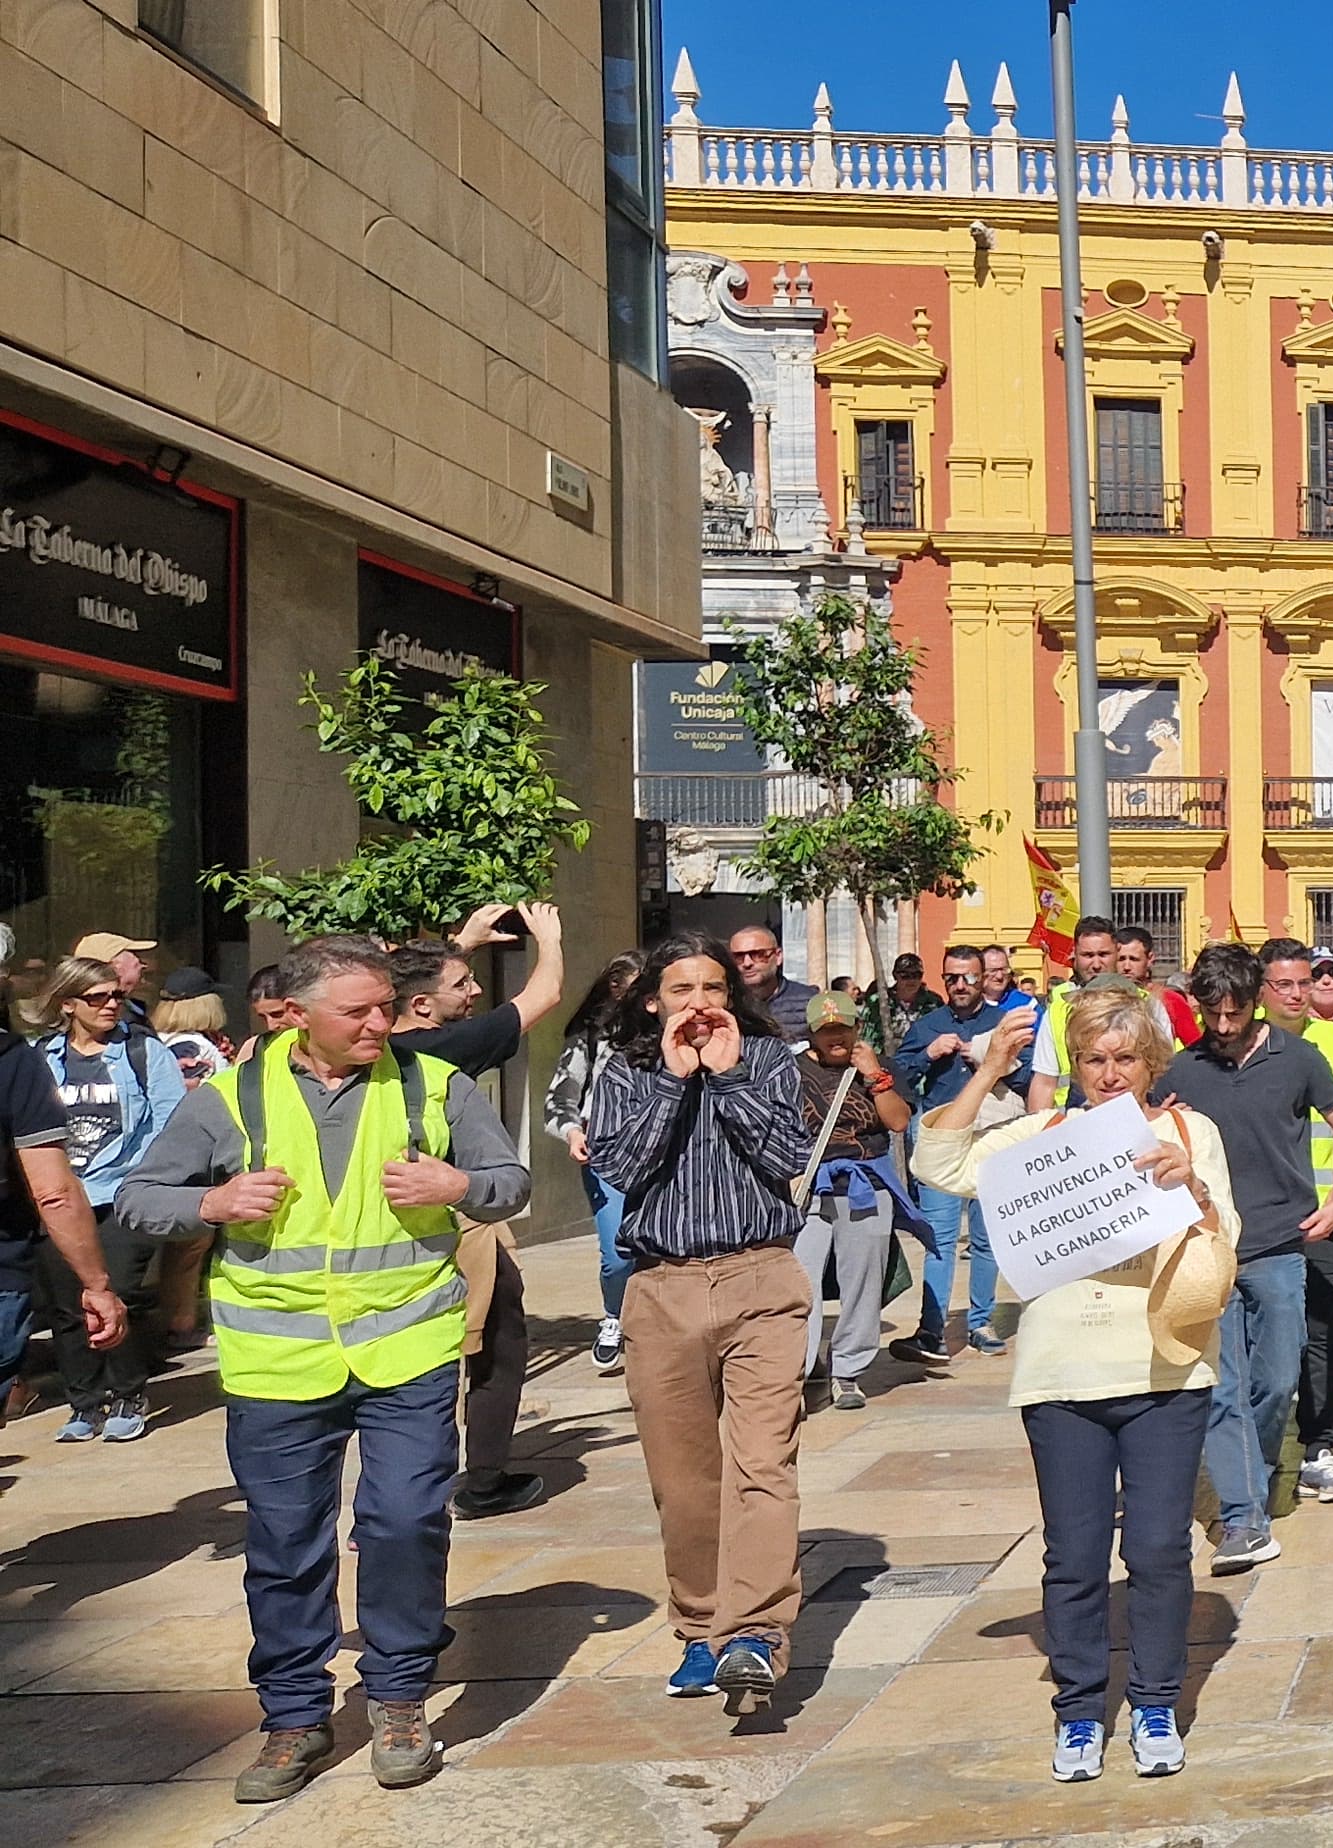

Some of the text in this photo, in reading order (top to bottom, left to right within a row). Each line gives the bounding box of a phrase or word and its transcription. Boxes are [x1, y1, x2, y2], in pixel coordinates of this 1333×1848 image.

[26, 515, 112, 576] Taberna
[113, 544, 143, 585] del
[143, 551, 207, 607] Obispo
[78, 596, 139, 631] MÁLAGA
[670, 690, 745, 705] Fundación
[681, 706, 735, 722] Unicaja
[674, 731, 744, 741] Centro Cultural
[692, 741, 727, 753] Málaga
[1024, 1145, 1077, 1176] POR LA
[997, 1148, 1137, 1220] SUPERVIVENCIA DE
[1008, 1171, 1149, 1247] LA AGRICULTURA Y
[1035, 1205, 1151, 1267] LA GANADERIA
